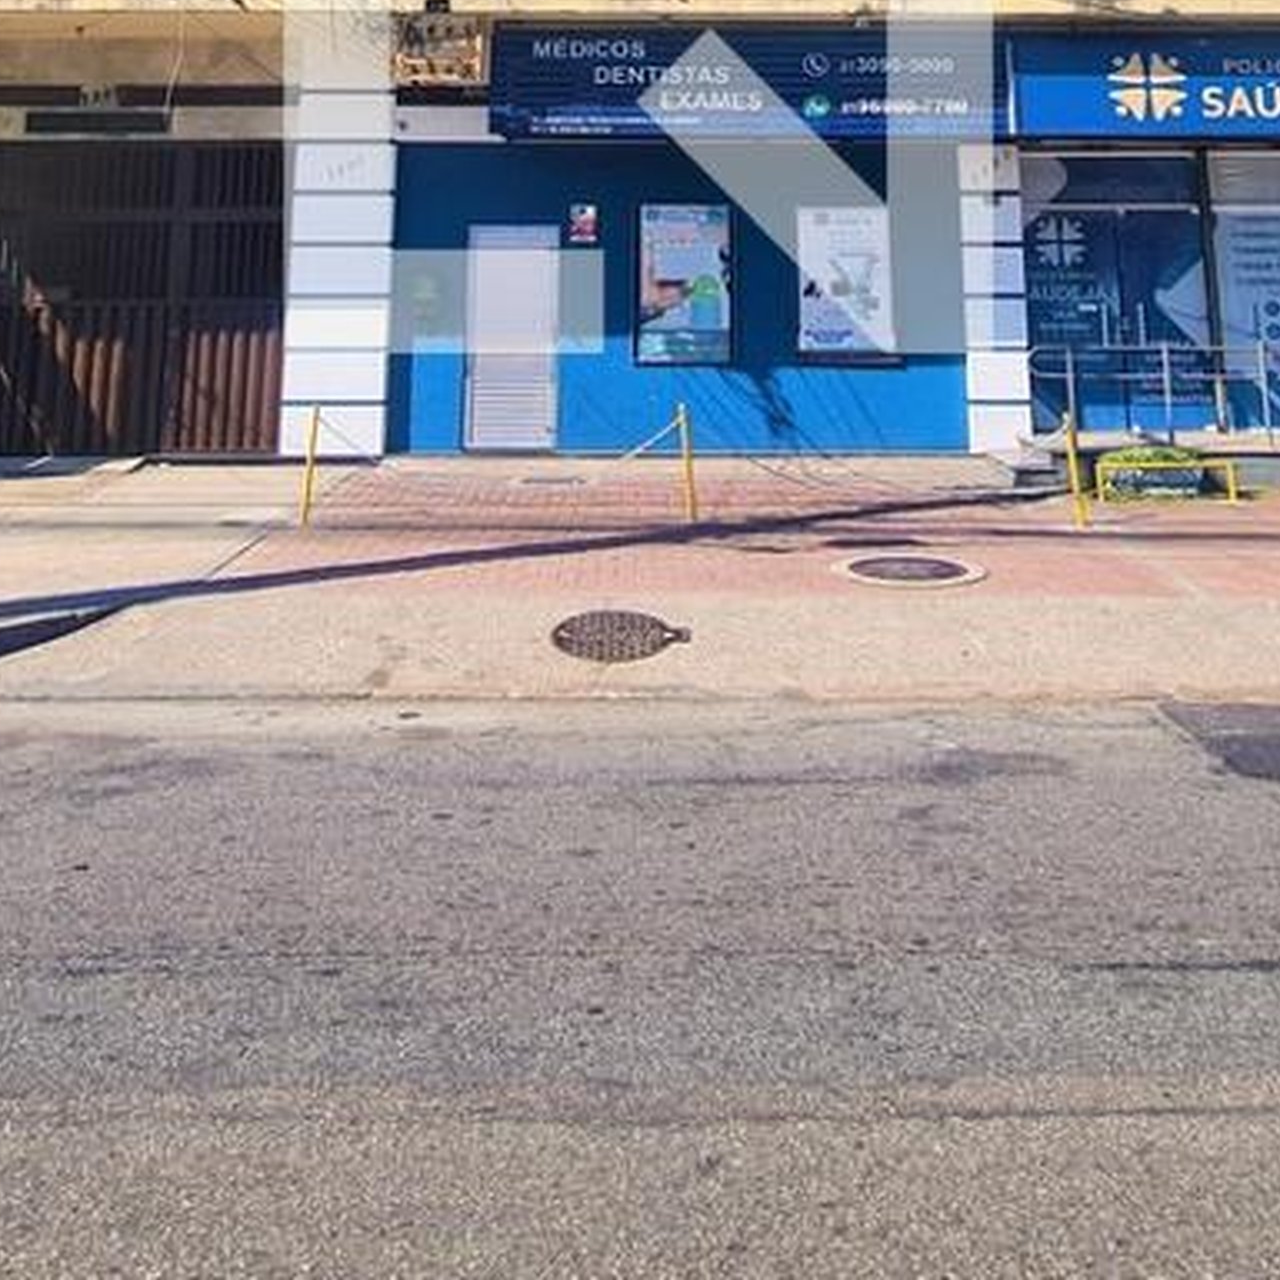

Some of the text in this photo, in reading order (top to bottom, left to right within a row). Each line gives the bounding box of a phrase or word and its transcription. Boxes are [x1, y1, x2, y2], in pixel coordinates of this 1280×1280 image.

[532, 38, 646, 59] MÉDICOS
[593, 65, 729, 84] DENTISTAS
[659, 91, 762, 111] EXAMES
